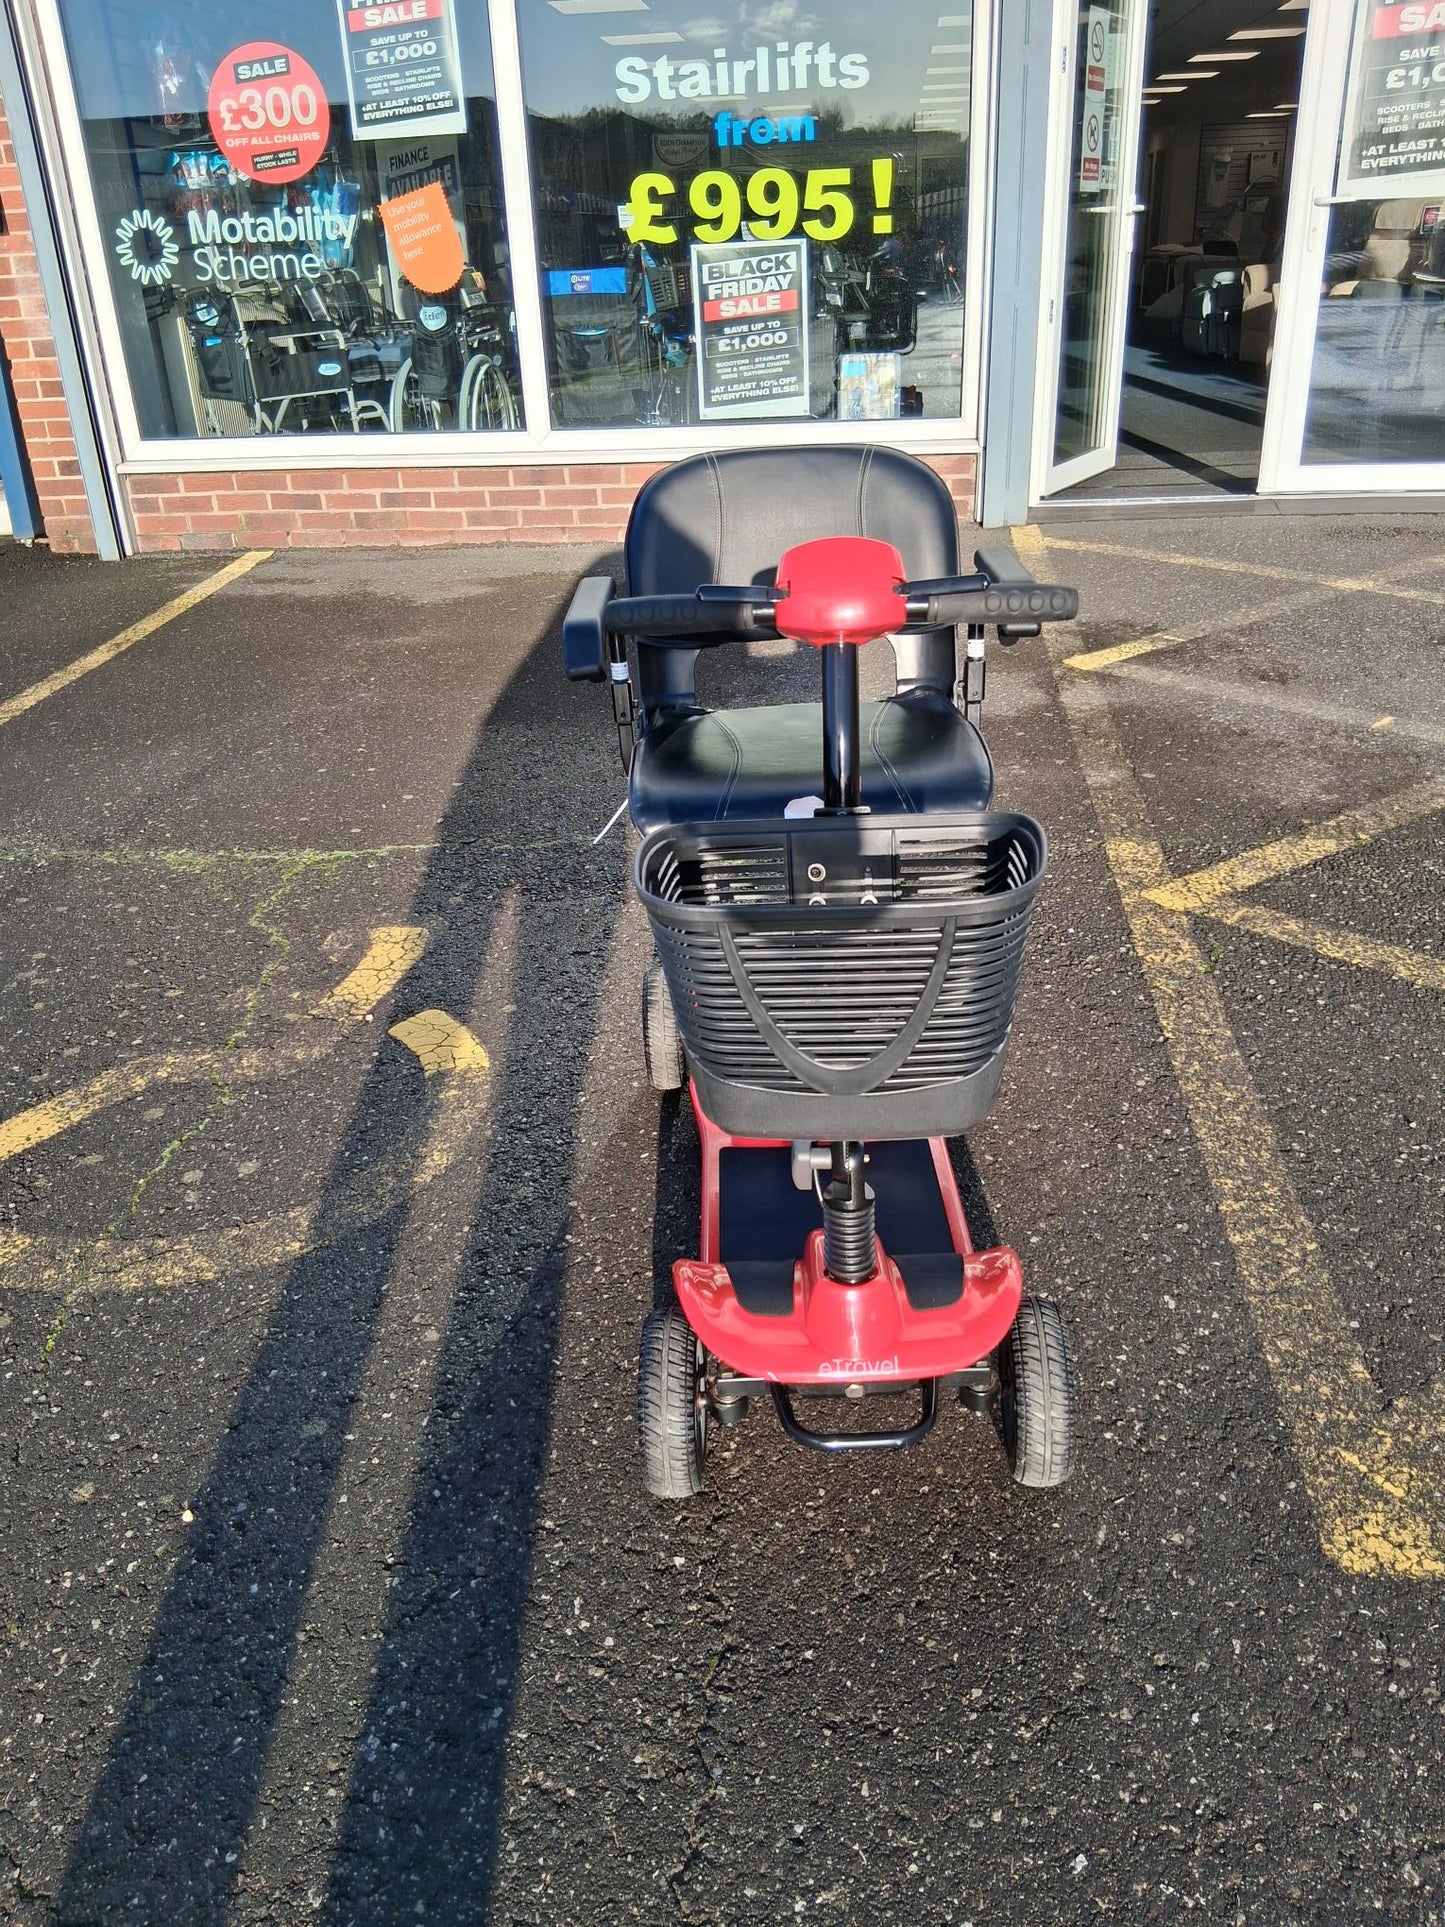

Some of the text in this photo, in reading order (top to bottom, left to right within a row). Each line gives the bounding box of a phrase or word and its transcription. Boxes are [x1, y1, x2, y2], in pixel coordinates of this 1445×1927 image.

[364, 1, 427, 27] SALE
[370, 29, 428, 46] SAVE UP TO
[365, 41, 437, 66] £1,000
[1399, 45, 1440, 61] SAVE
[237, 58, 288, 80] SALE
[364, 66, 441, 83] SCOOTERS STAIRLIFTS
[615, 41, 871, 104] Stairlifts
[367, 81, 382, 89] RISE
[389, 77, 417, 86] RECLINE
[418, 73, 442, 81] CHAIRS
[371, 81, 435, 96] BEDS BATHROOMS
[219, 84, 317, 131] £300
[362, 91, 451, 112] +AT LEAST 10% OFF
[363, 99, 454, 120] EVERYTHING ELSE!
[1377, 101, 1431, 115] SCOOTERS
[714, 110, 815, 147] from
[1377, 114, 1401, 125] RISE
[1402, 113, 1410, 122] &
[1382, 119, 1445, 134] BEDS BATH
[226, 131, 320, 148] OFF ALL CHAIRS
[1361, 144, 1386, 157] +AT
[1389, 138, 1437, 154] LEAST
[253, 154, 274, 163] HURRY
[279, 150, 297, 159] WHILE
[256, 157, 297, 169] STOCK LASTS
[389, 146, 429, 172] FINANCE
[1361, 150, 1445, 170] EVERYTHIN
[387, 197, 425, 218] Use your
[187, 205, 357, 249] Motability
[393, 212, 430, 233] mobility
[399, 223, 443, 247] allowance
[403, 246, 424, 261] here
[193, 247, 321, 281] Scheme
[707, 254, 792, 281] BLACK
[708, 273, 793, 300] FRIDAY
[720, 294, 780, 317] SALE
[724, 320, 780, 335] SAVE UP TO
[718, 331, 788, 352] £1,000
[715, 353, 789, 368] SCOOTERS STAIRLIFTS
[717, 365, 731, 373] RISE
[739, 363, 766, 371] RECLINE
[766, 359, 790, 367] CHAIRS
[743, 367, 783, 377] BATHROOMS
[710, 376, 797, 395] +AT LEAST 10% OFF
[711, 384, 799, 402] EVERYTHING ELSE!
[819, 1355, 899, 1376] eTravel
